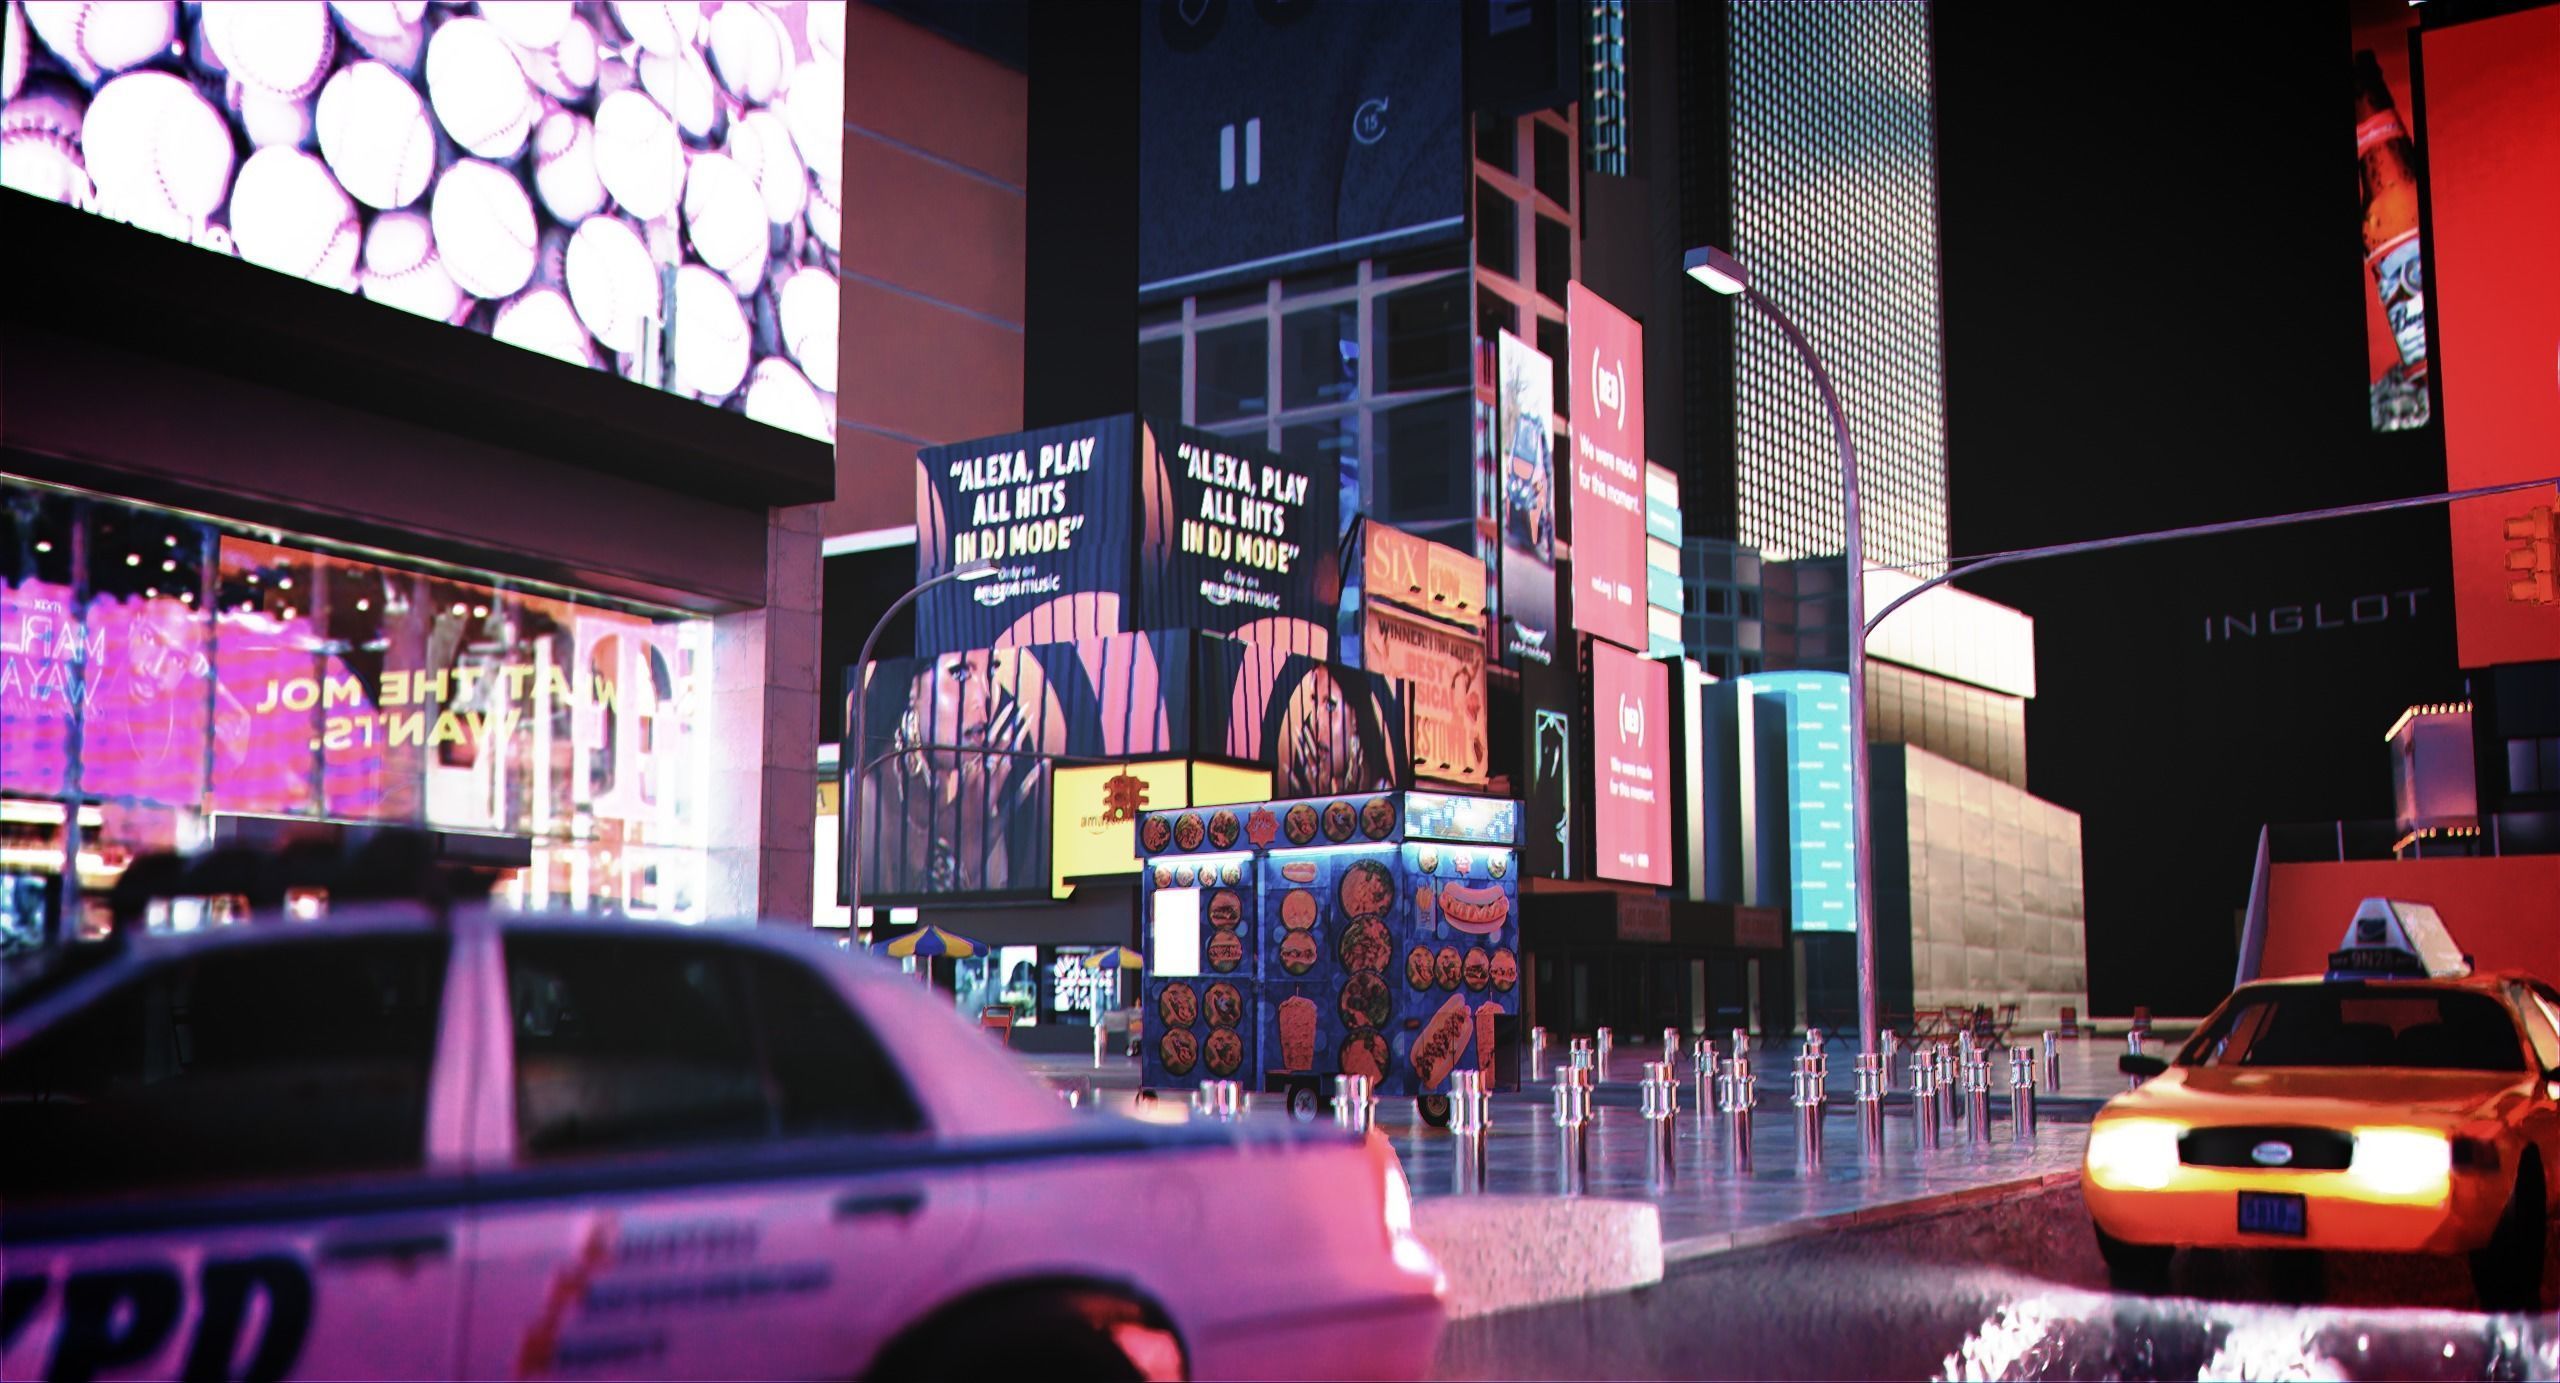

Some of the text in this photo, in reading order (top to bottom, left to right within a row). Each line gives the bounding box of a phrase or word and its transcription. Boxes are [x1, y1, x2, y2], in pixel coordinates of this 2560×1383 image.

[950, 436, 1096, 492] “ALEXA, PLAY
[1178, 442, 1309, 507] “ALEXA, PLAY
[1578, 464, 1591, 491] for
[1591, 471, 1606, 499] this
[1579, 432, 1638, 483] We were made
[972, 479, 1066, 526] ALL HITS
[1200, 486, 1285, 537] ALL HITS
[954, 514, 1085, 565] IN DJ MODE”
[1181, 518, 1300, 575] IN DJ MODE”
[2205, 588, 2430, 643] INGLOT
